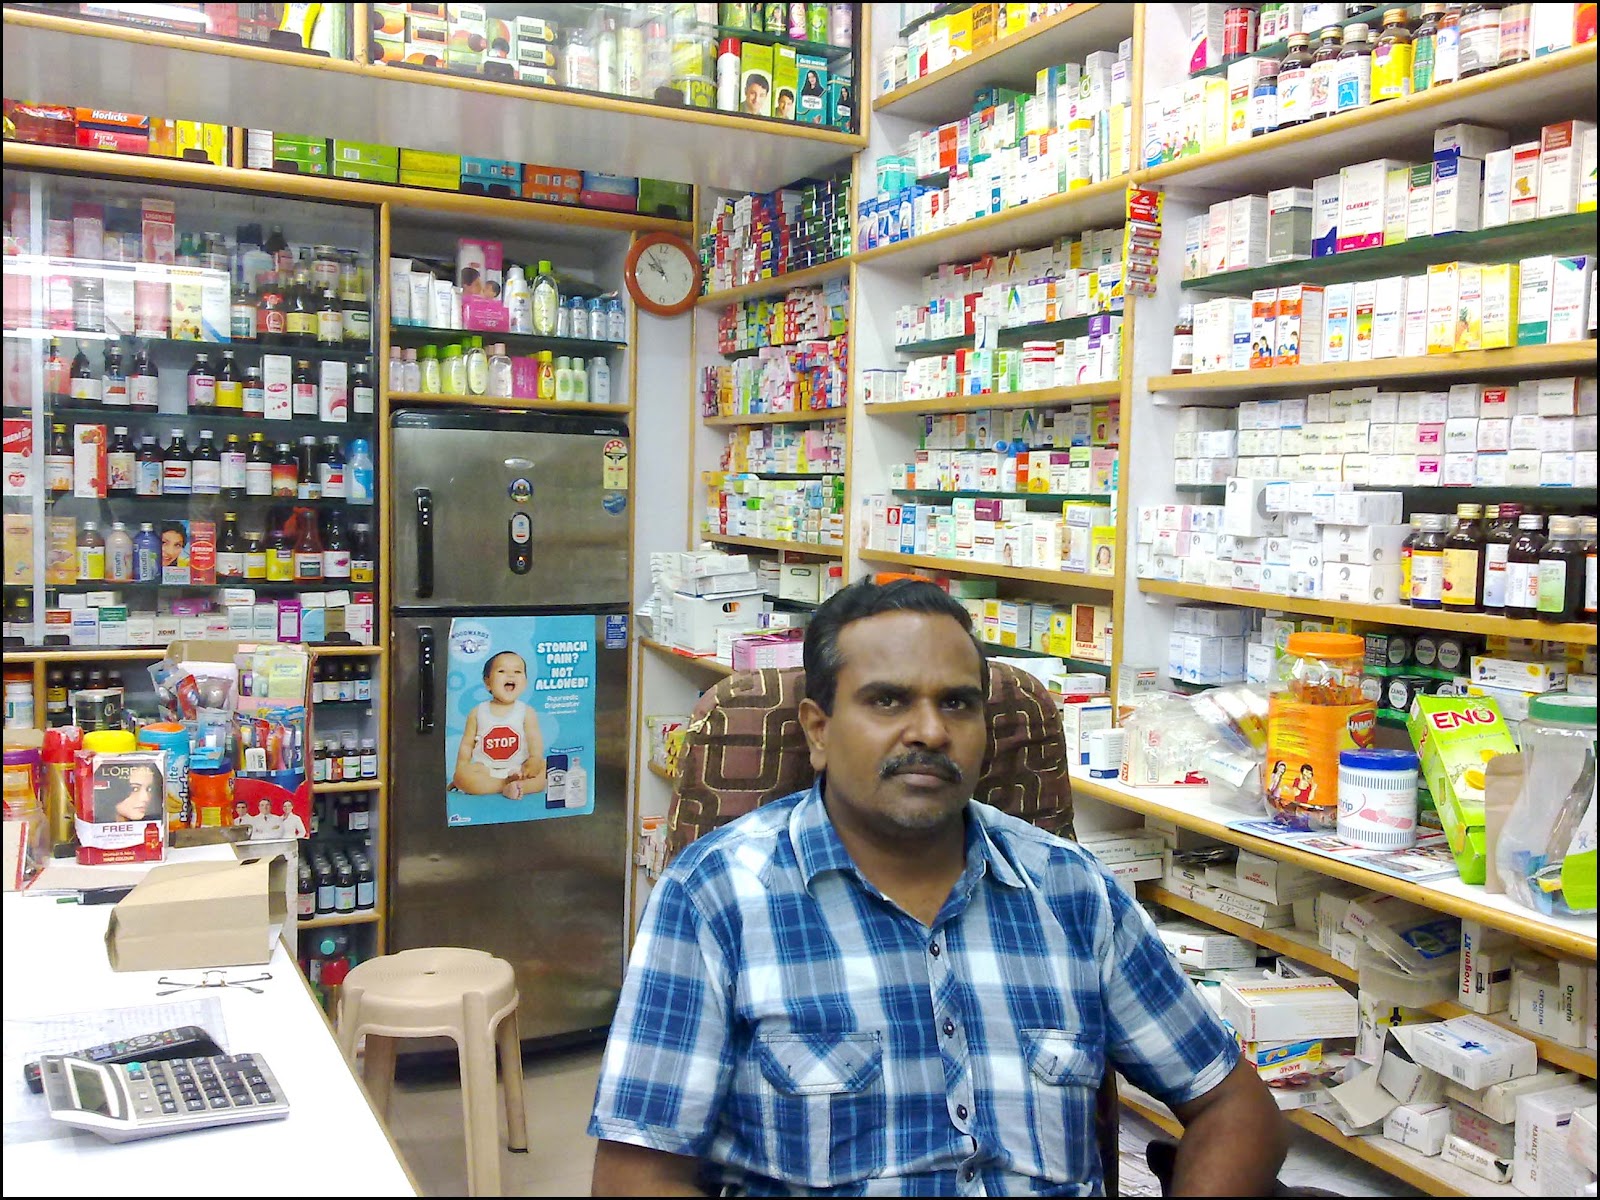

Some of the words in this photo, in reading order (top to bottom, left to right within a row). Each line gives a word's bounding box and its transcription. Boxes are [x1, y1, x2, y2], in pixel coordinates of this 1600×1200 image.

[92, 110, 128, 123] Horlicks
[94, 132, 114, 142] First
[98, 139, 118, 148] Food
[660, 245, 669, 254] 12
[536, 641, 588, 654] STOMACH
[546, 653, 579, 665] PAIN?
[551, 667, 574, 678] NOT
[535, 677, 589, 691] ALLOWED!
[1432, 708, 1496, 731] ENO
[486, 737, 517, 750] STOP
[102, 824, 134, 833] FREE
[1462, 951, 1473, 994] Livogen
[1566, 985, 1574, 1022] Orcerin
[1449, 1142, 1475, 1161] Macpod
